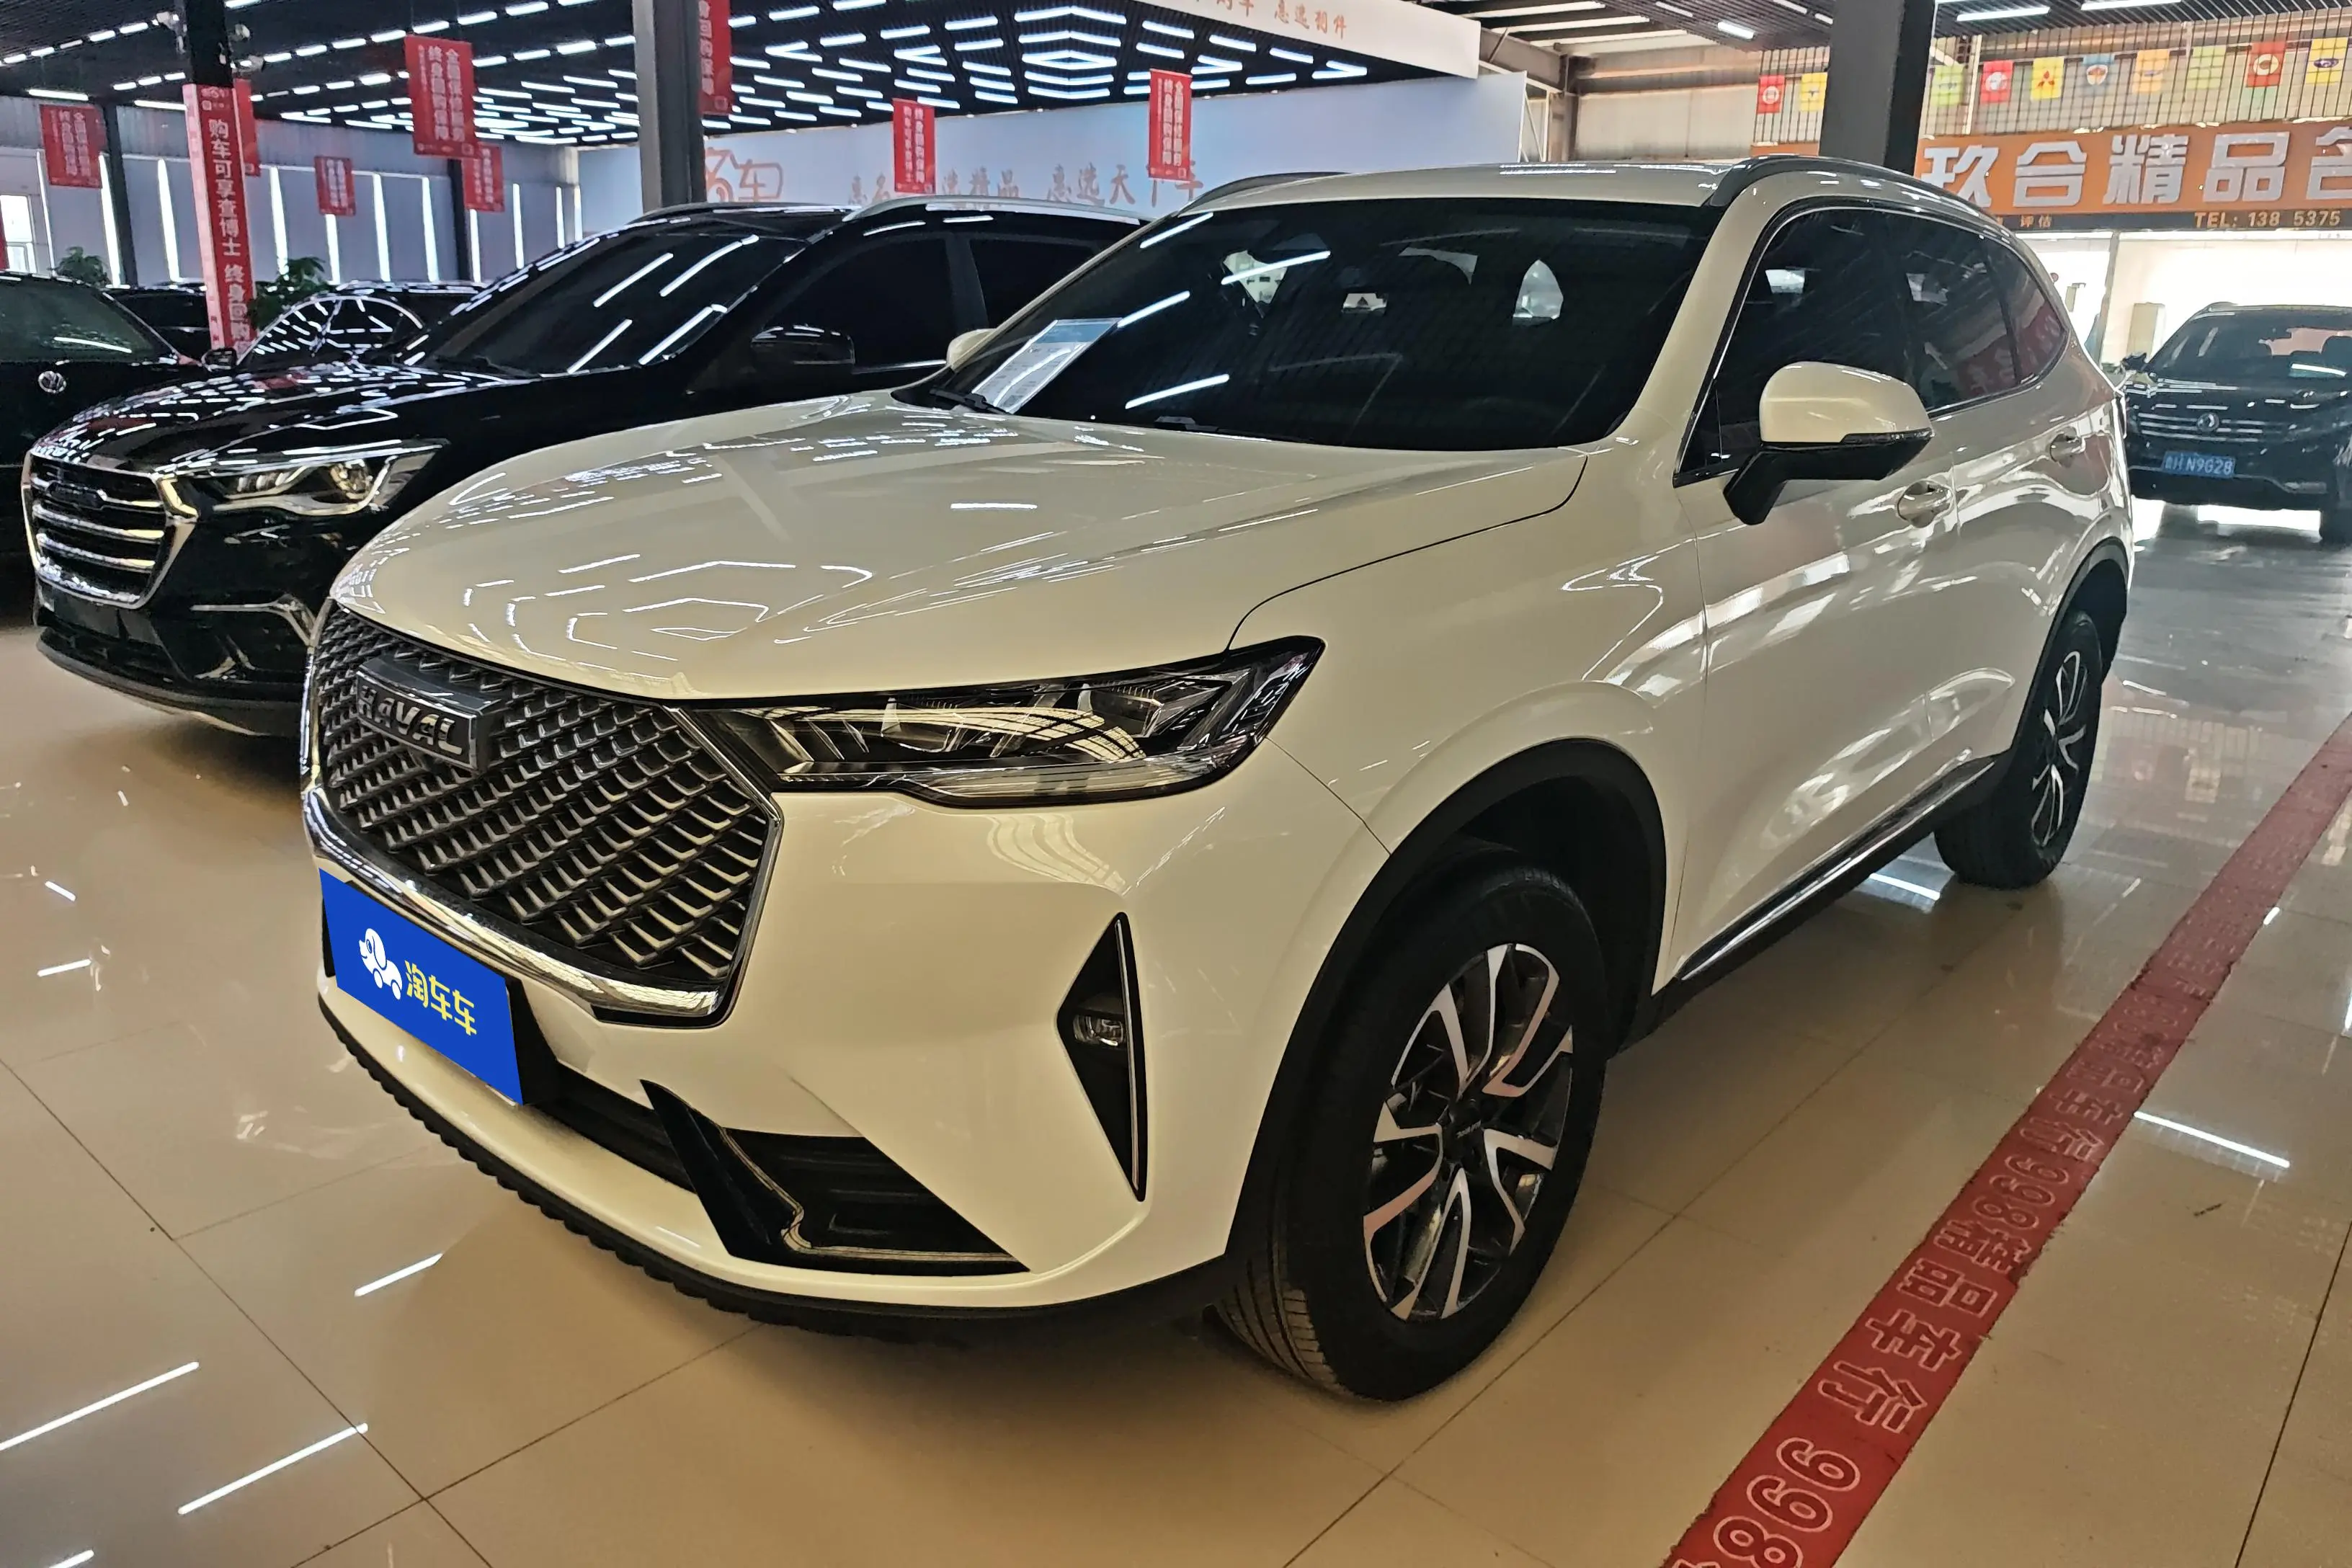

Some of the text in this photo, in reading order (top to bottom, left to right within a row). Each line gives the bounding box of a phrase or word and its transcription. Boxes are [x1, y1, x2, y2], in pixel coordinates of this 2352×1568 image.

[2195, 210, 2341, 228] TEL: 138 5375
[358, 684, 463, 756] HAVAL
[1817, 1154, 2070, 1434] 998精品车行
[1672, 1436, 1861, 1568] 998
